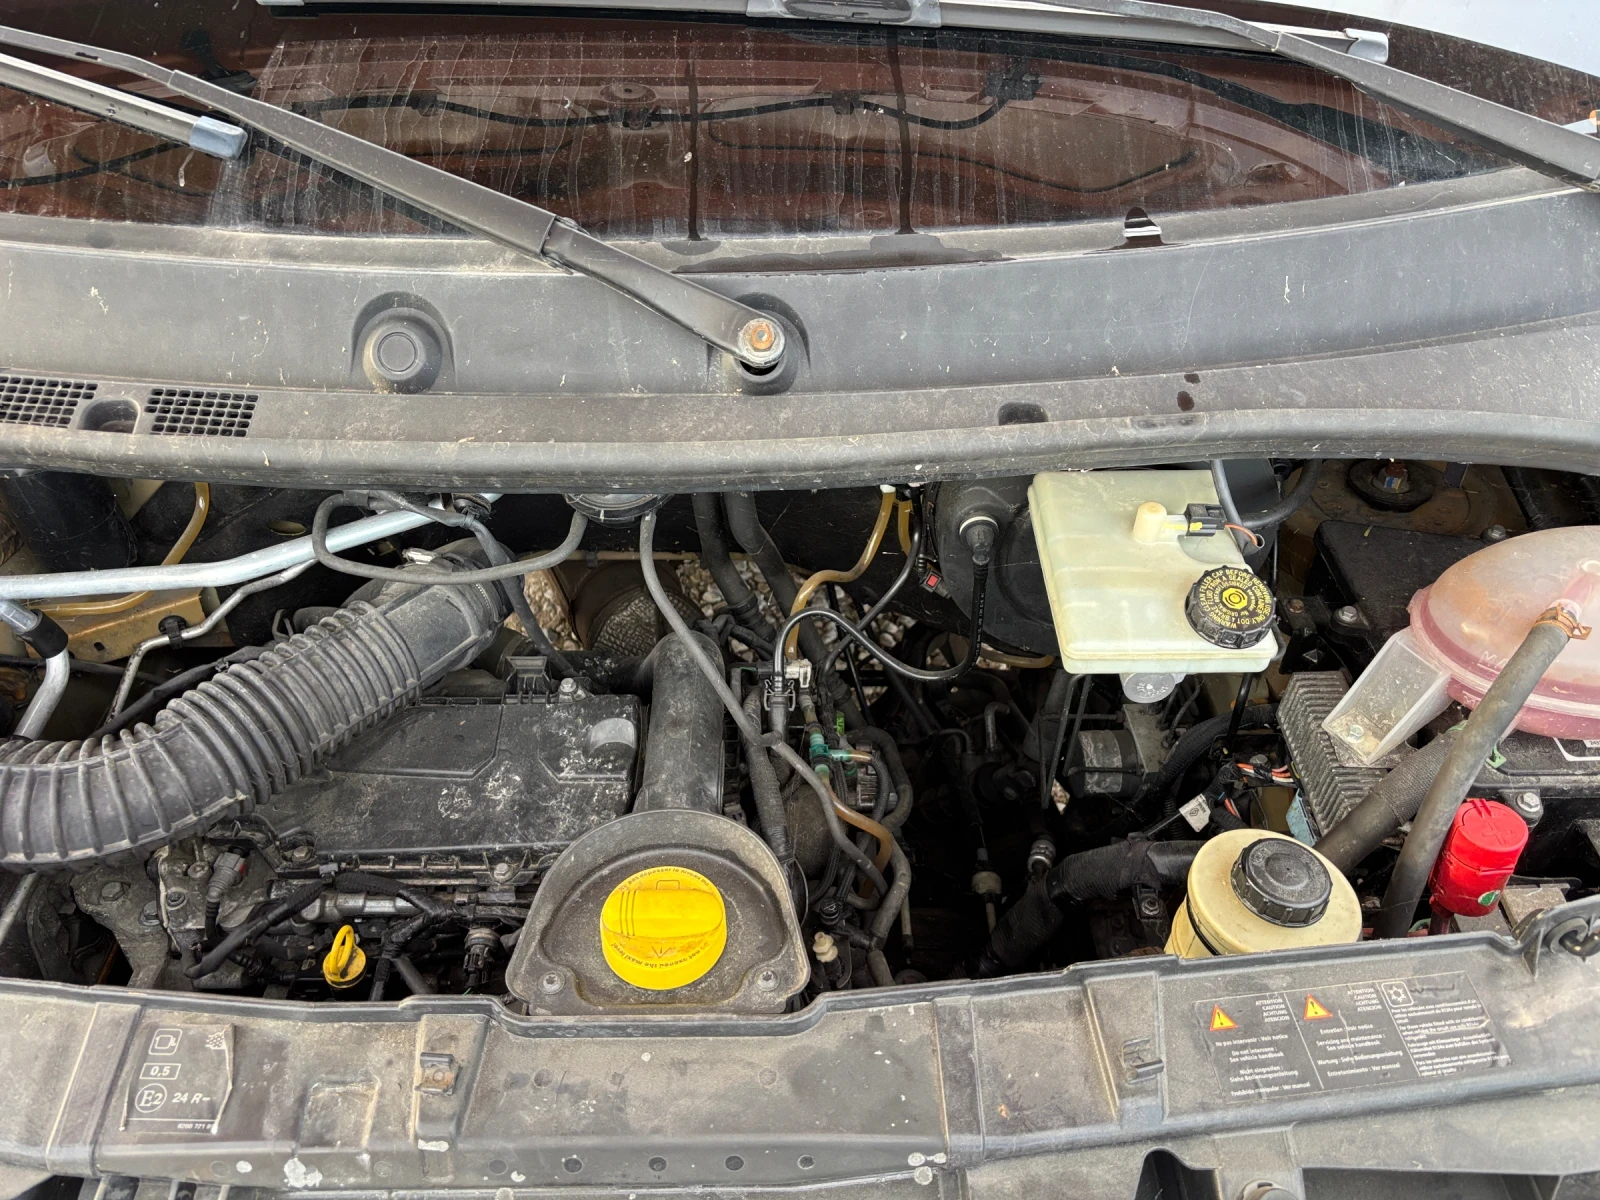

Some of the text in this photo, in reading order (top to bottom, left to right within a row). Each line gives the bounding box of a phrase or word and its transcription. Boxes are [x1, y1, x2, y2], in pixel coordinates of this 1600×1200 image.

[1212, 570, 1224, 578] CAP
[1226, 569, 1251, 579] BEFORE
[1229, 574, 1253, 586] SEALED
[1200, 576, 1212, 592] FILLER
[1208, 579, 1222, 590] FROM
[1252, 578, 1272, 603] REMOVING
[1200, 594, 1210, 612] CLEAN
[1211, 606, 1232, 620] BRAKE
[1263, 604, 1272, 616] USE
[1208, 612, 1237, 628] WARNING
[1252, 615, 1265, 624] ONLY
[150, 1066, 170, 1078] 0,5
[139, 1090, 163, 1106] E2
[172, 1092, 188, 1103] 24
